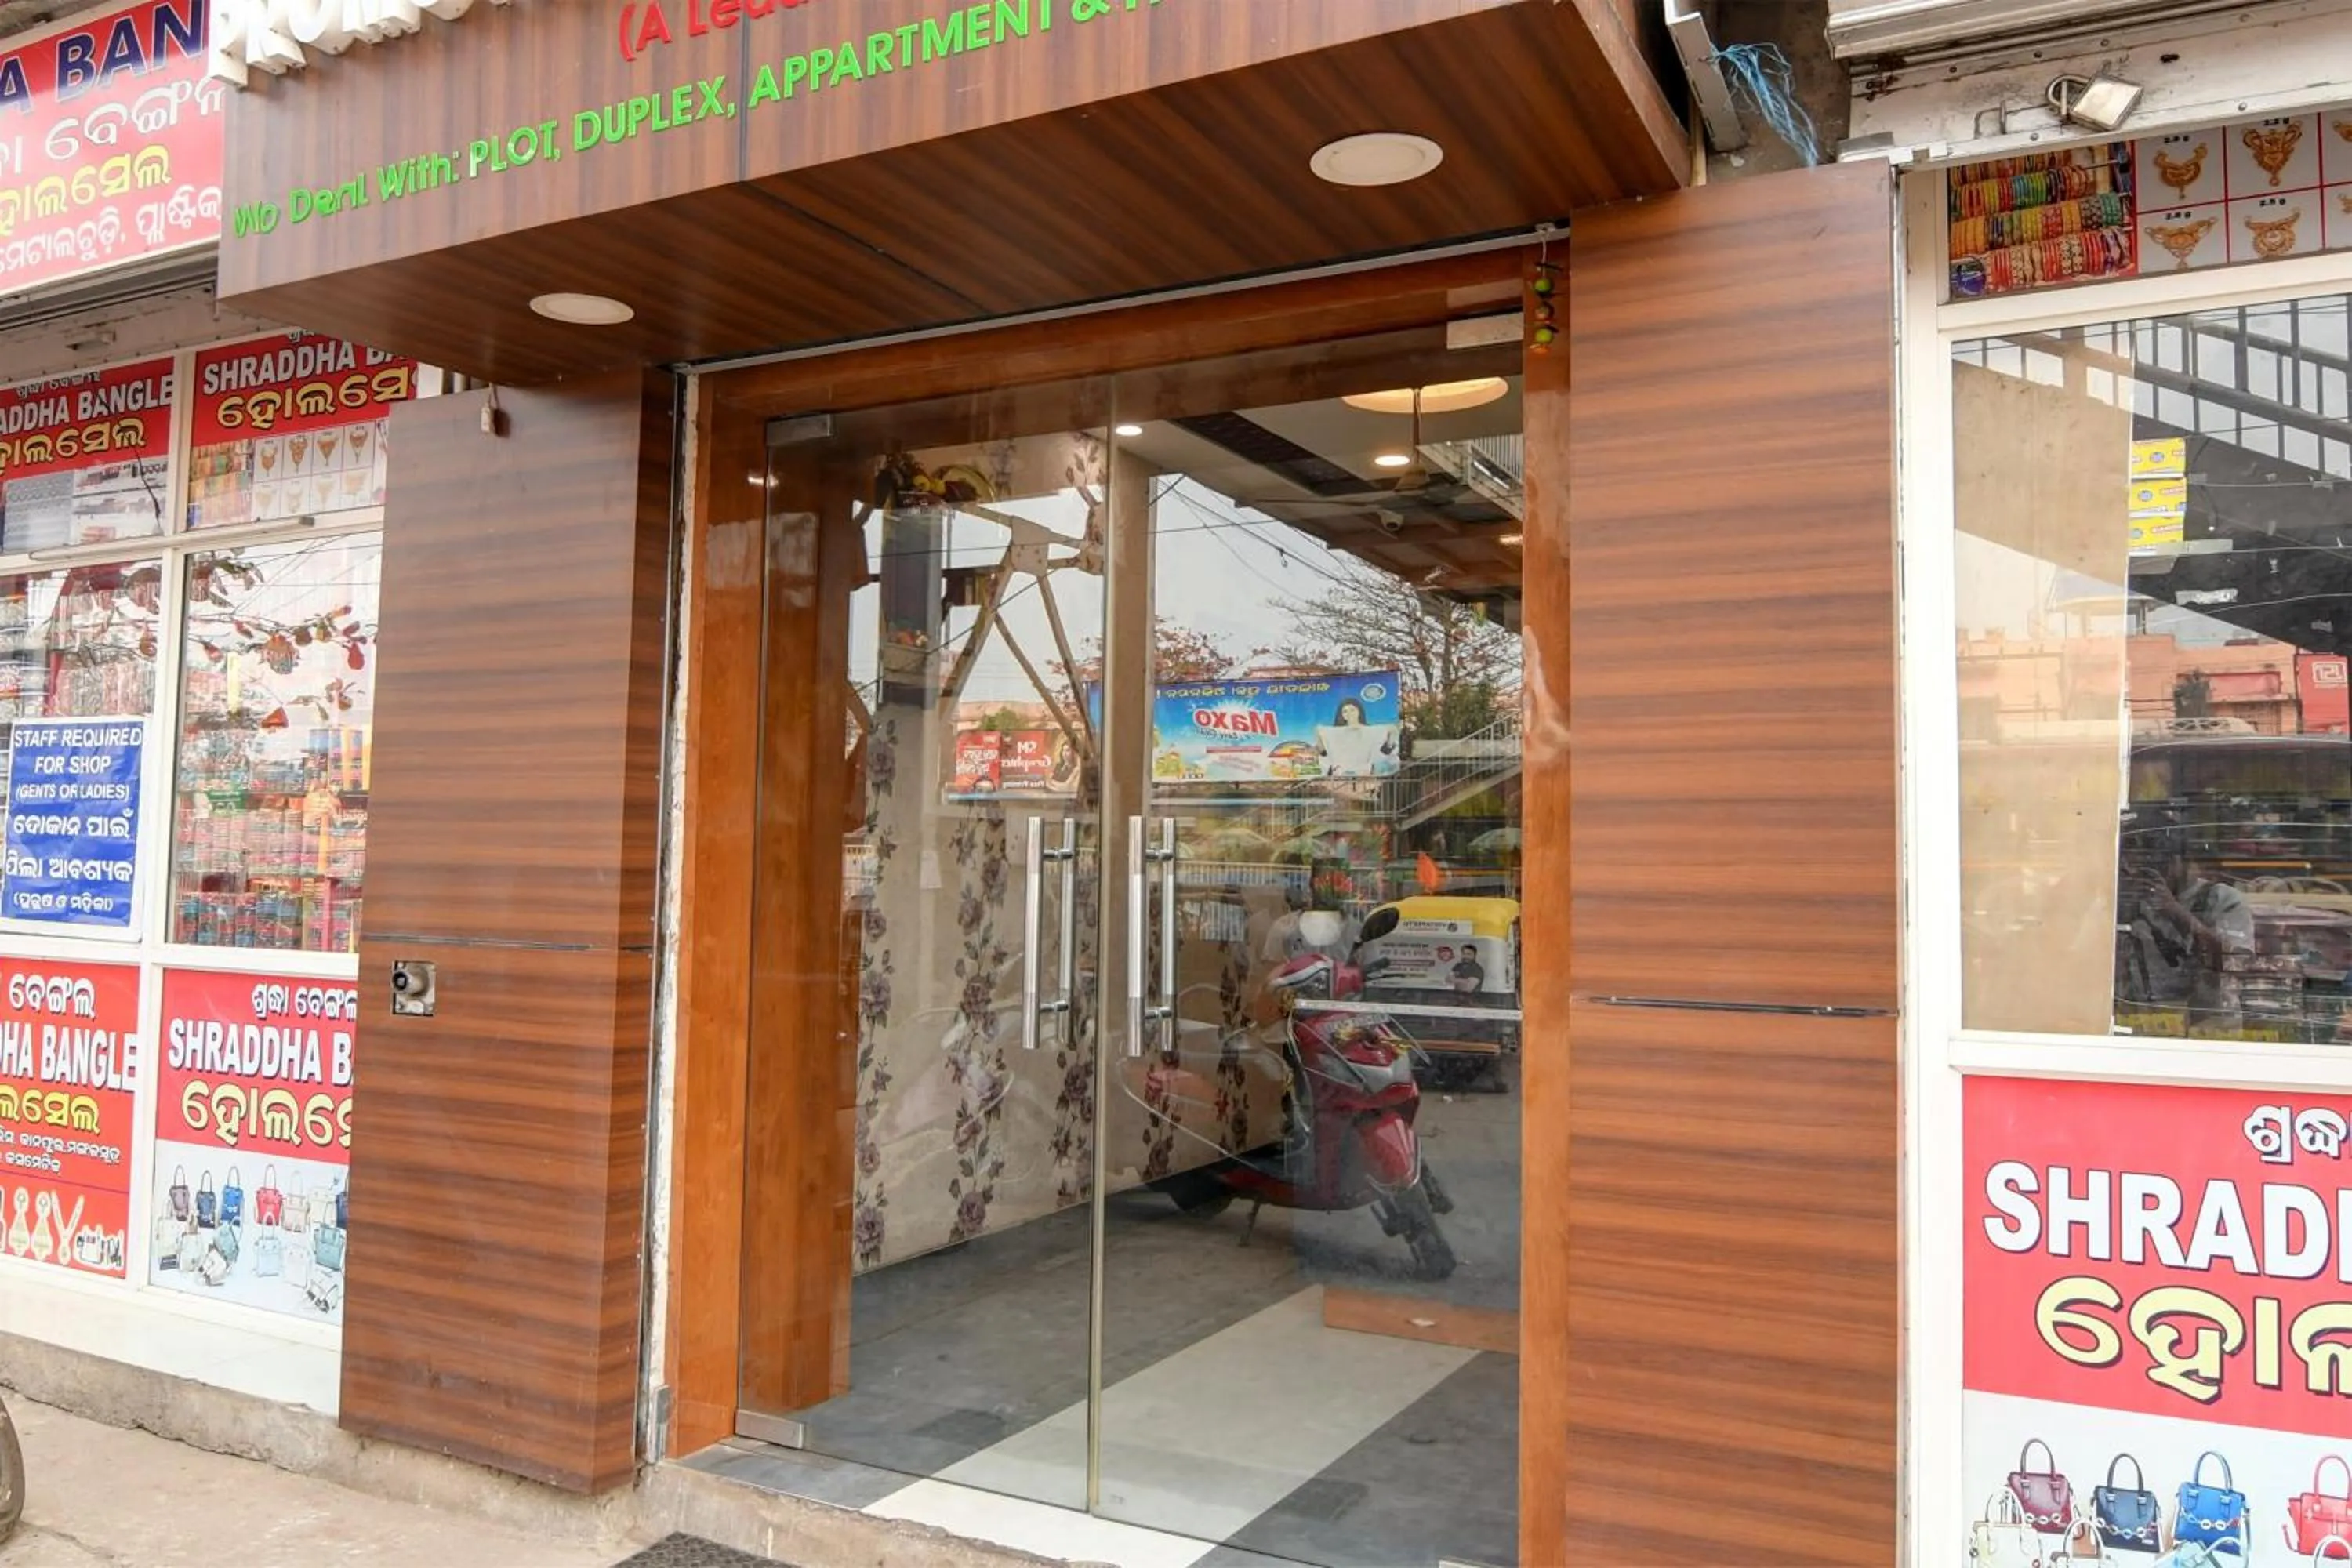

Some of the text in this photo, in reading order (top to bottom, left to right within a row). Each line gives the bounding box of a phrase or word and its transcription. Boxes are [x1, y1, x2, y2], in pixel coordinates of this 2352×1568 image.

[469, 121, 561, 177] PLOT,
[574, 76, 736, 152] DUPLEX,
[747, 0, 1053, 108] APPARTMENT
[203, 339, 356, 395] SHRADDHA
[78, 375, 173, 422] BANGLE
[14, 727, 143, 748] STAFF REQUIRED
[34, 755, 111, 774] FOR SHOP
[16, 784, 129, 801] (GENTS OR LADIES)
[0, 1021, 139, 1093] HA BANGLE
[168, 1017, 354, 1087] SHRADDHA B
[1982, 1160, 2352, 1283] SHRAD
